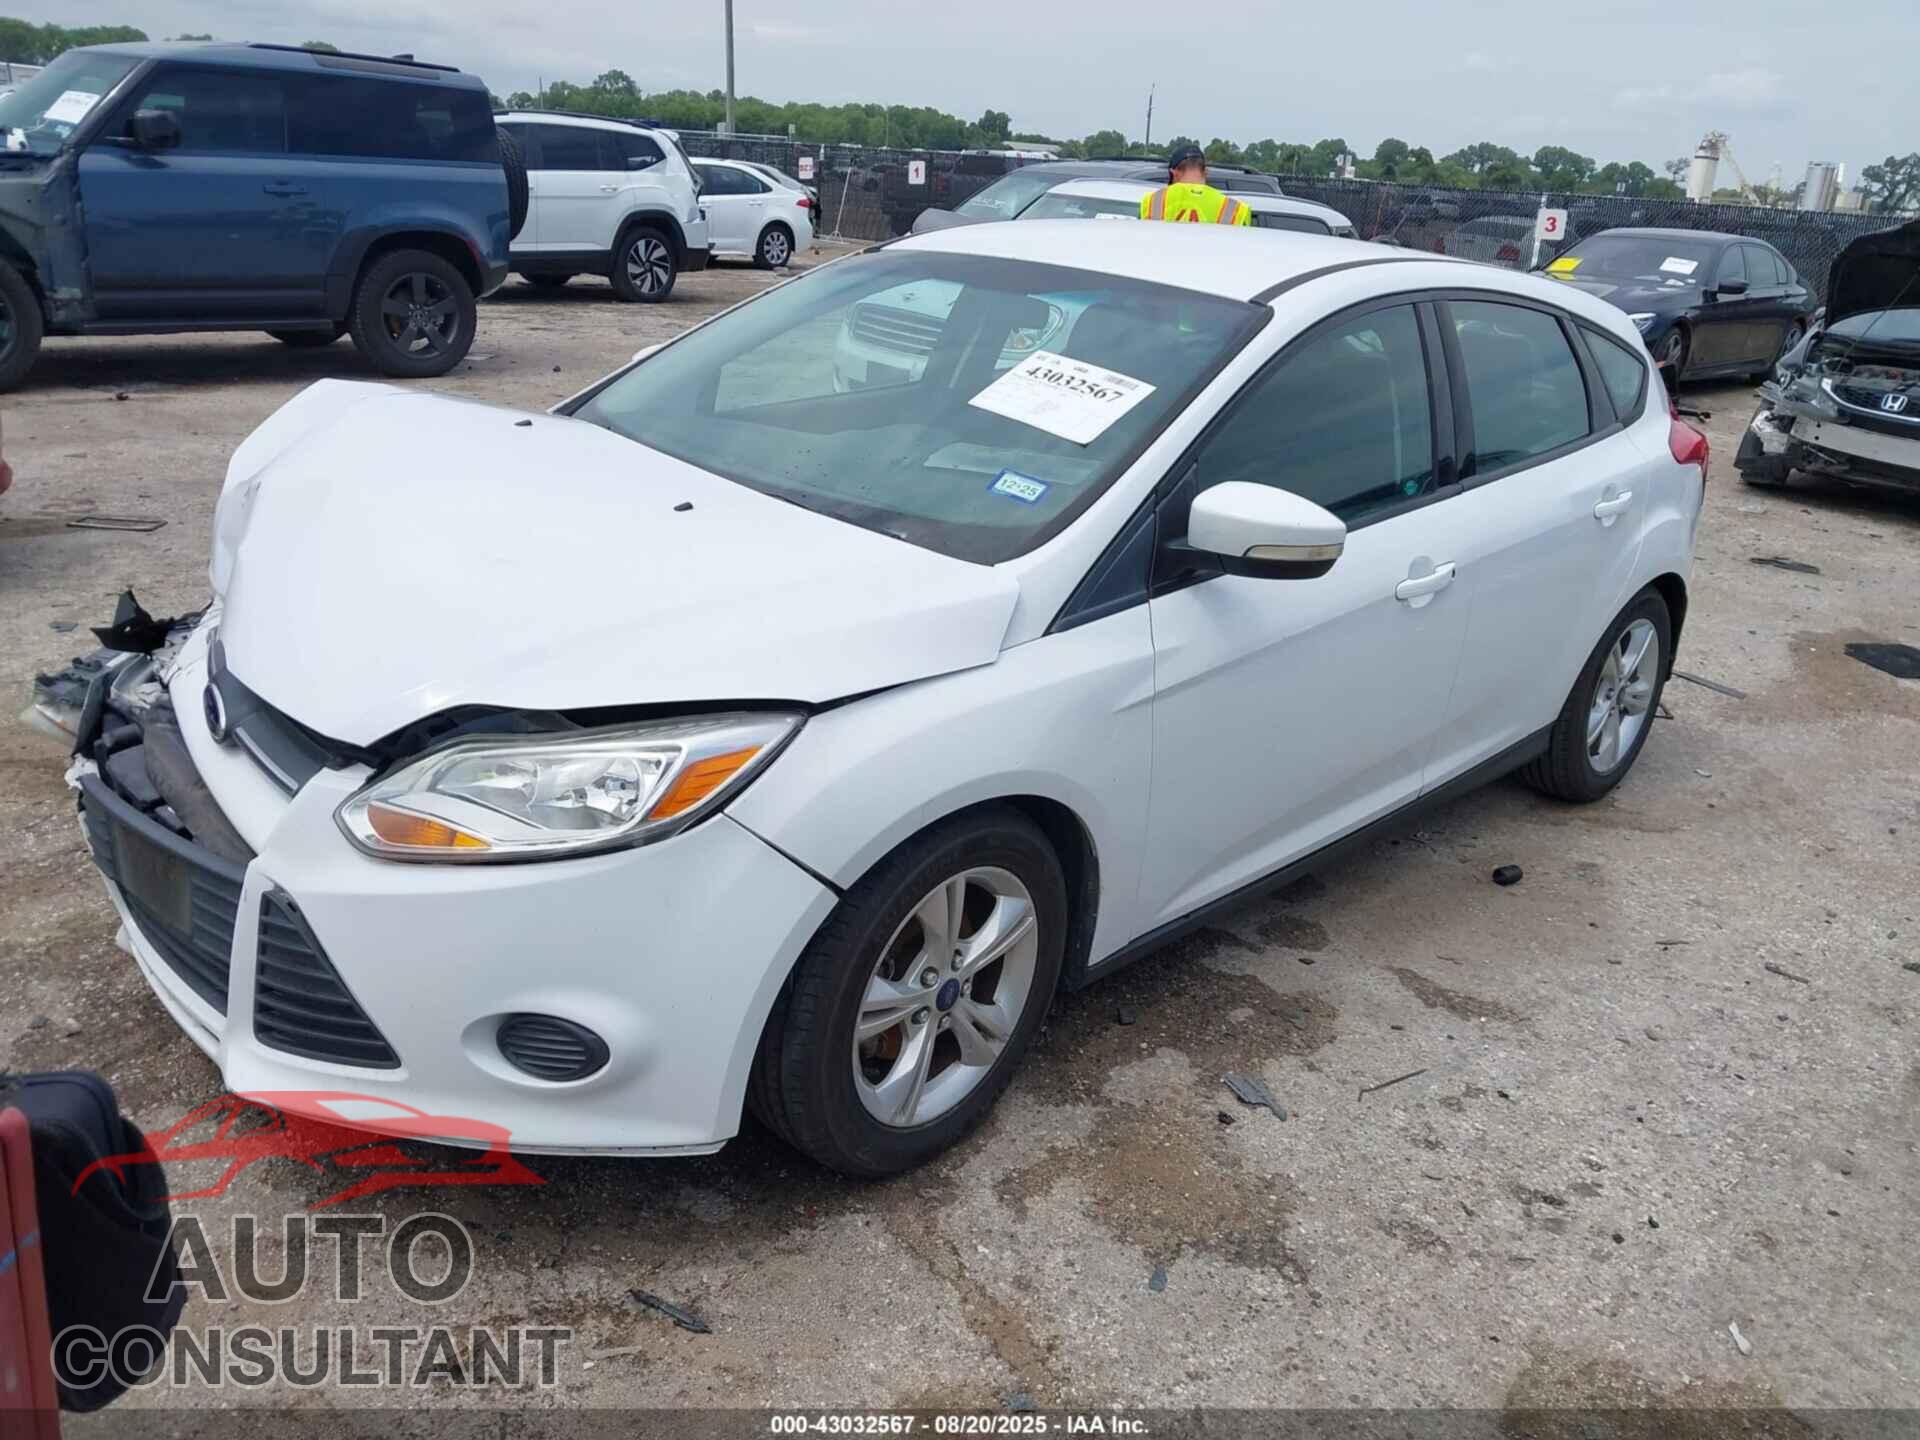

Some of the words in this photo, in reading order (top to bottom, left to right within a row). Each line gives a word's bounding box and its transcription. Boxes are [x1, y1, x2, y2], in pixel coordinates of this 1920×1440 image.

[913, 165, 920, 178] 1
[1544, 216, 1557, 232] 3
[1025, 365, 1125, 403] 43032567
